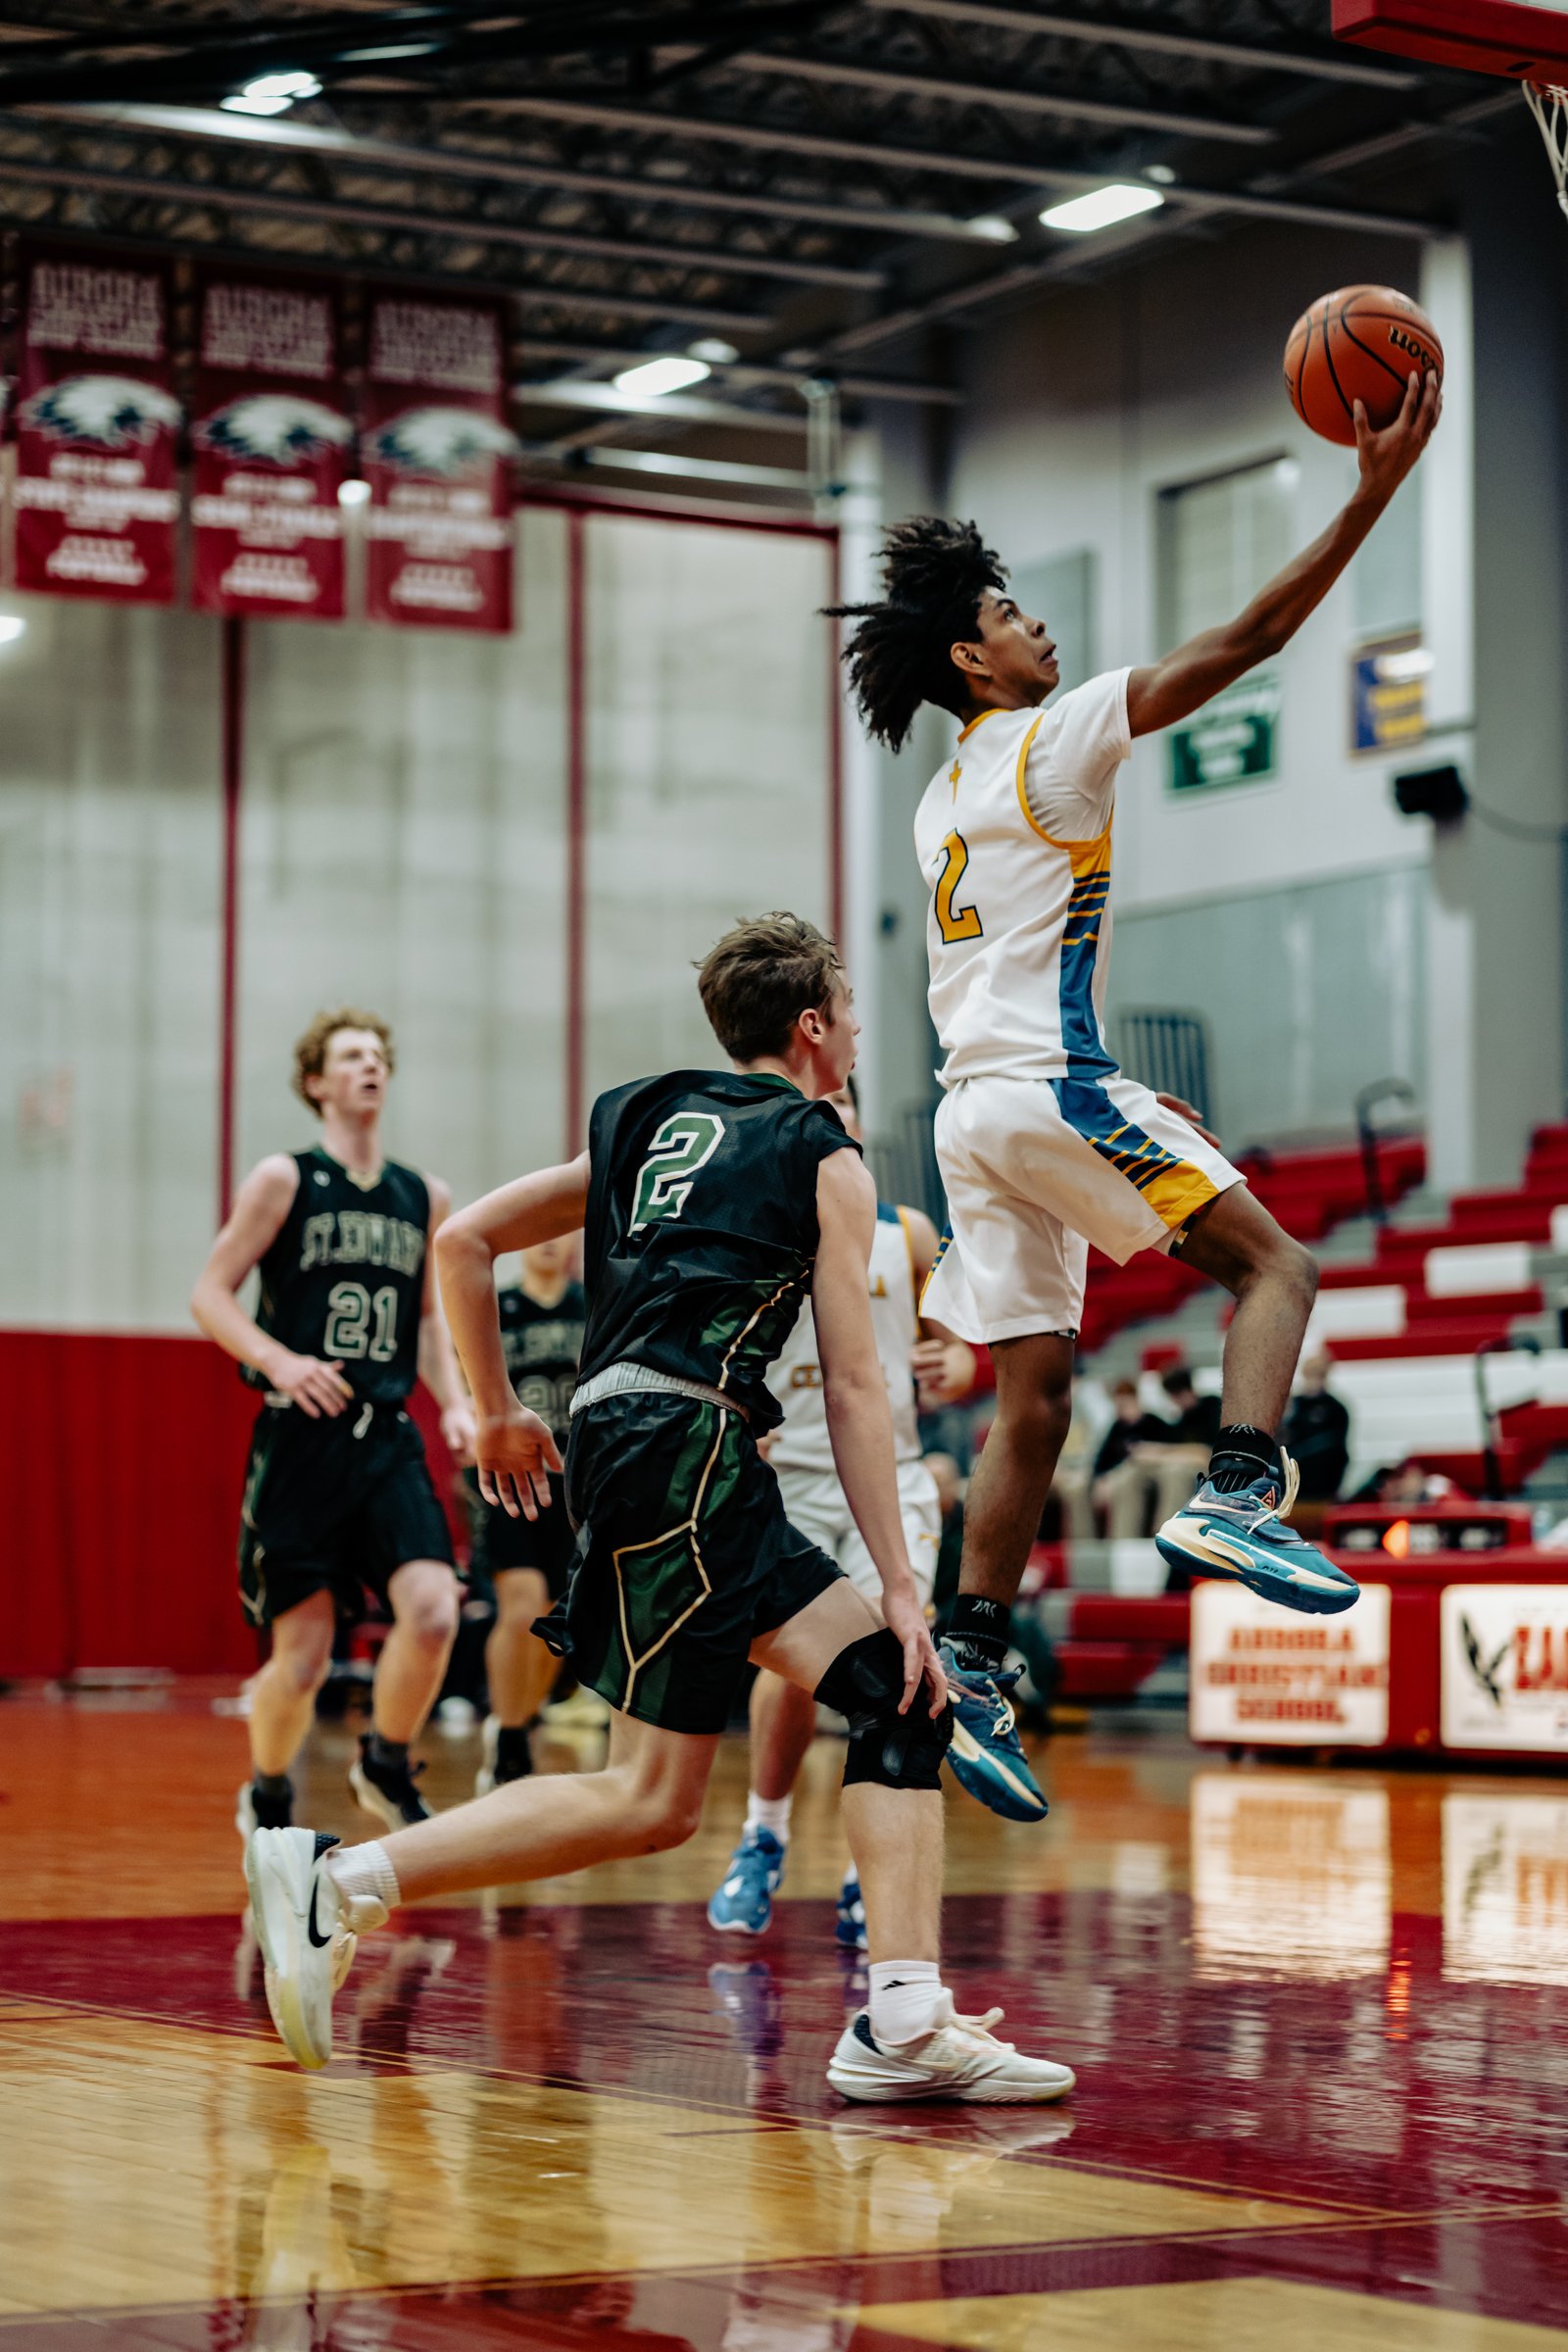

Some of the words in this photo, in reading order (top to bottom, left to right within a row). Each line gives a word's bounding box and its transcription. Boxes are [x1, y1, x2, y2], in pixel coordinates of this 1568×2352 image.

[932, 827, 984, 946] 2
[627, 1111, 726, 1238] 2
[323, 1281, 398, 1362] 21
